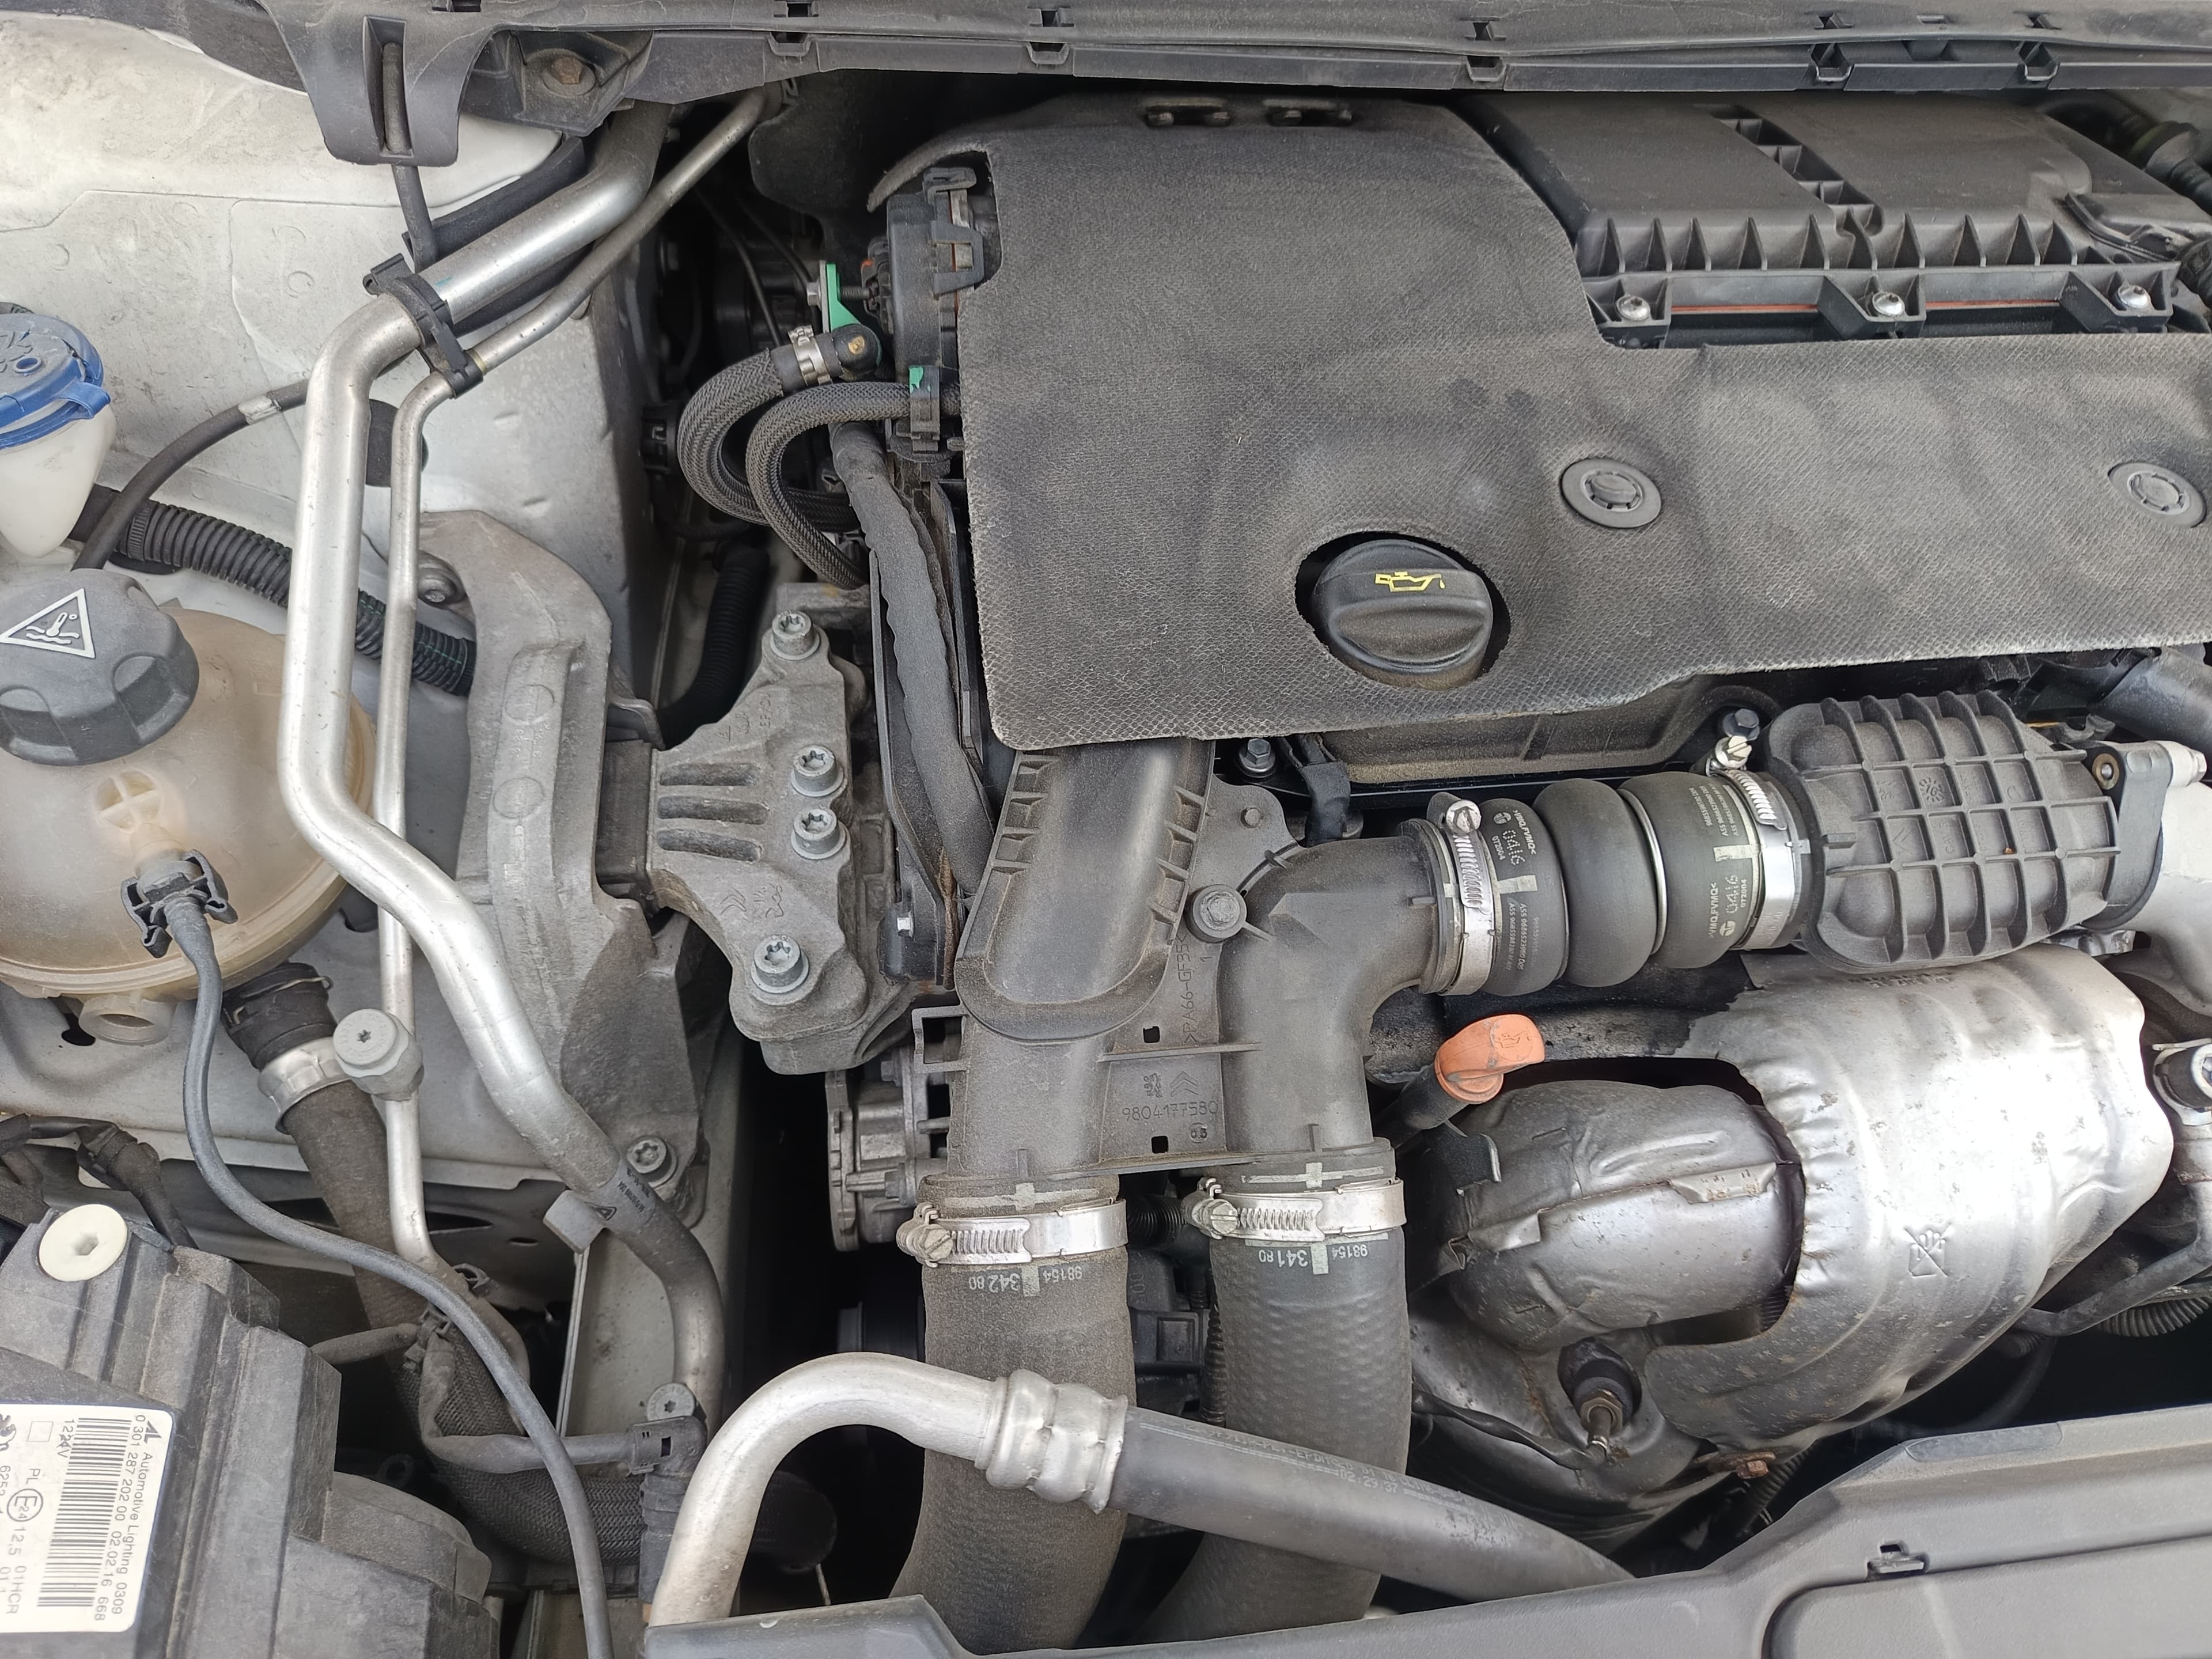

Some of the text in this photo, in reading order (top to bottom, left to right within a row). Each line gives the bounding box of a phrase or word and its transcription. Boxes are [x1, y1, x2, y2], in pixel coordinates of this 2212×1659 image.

[1719, 824, 1729, 836] ASS
[1730, 824, 1740, 836] ASS
[1492, 835, 1506, 860] 072004
[1123, 1100, 1219, 1122] 9804177580
[1331, 1244, 1369, 1260] 98154
[1043, 1266, 1082, 1283] 98154
[131, 1426, 143, 1446] 301
[126, 1452, 138, 1475] 287
[26, 1468, 40, 1484] PL
[130, 1452, 153, 1521] Automotive
[1340, 1469, 1398, 1494] 02:29:37
[119, 1479, 132, 1502] 202
[115, 1506, 127, 1521] 00
[101, 1531, 122, 1586] 02.02.16
[116, 1525, 139, 1574] Lighting
[5, 1565, 27, 1614] 01HCR
[111, 1582, 127, 1614] 0309
[94, 1596, 109, 1621] 668
